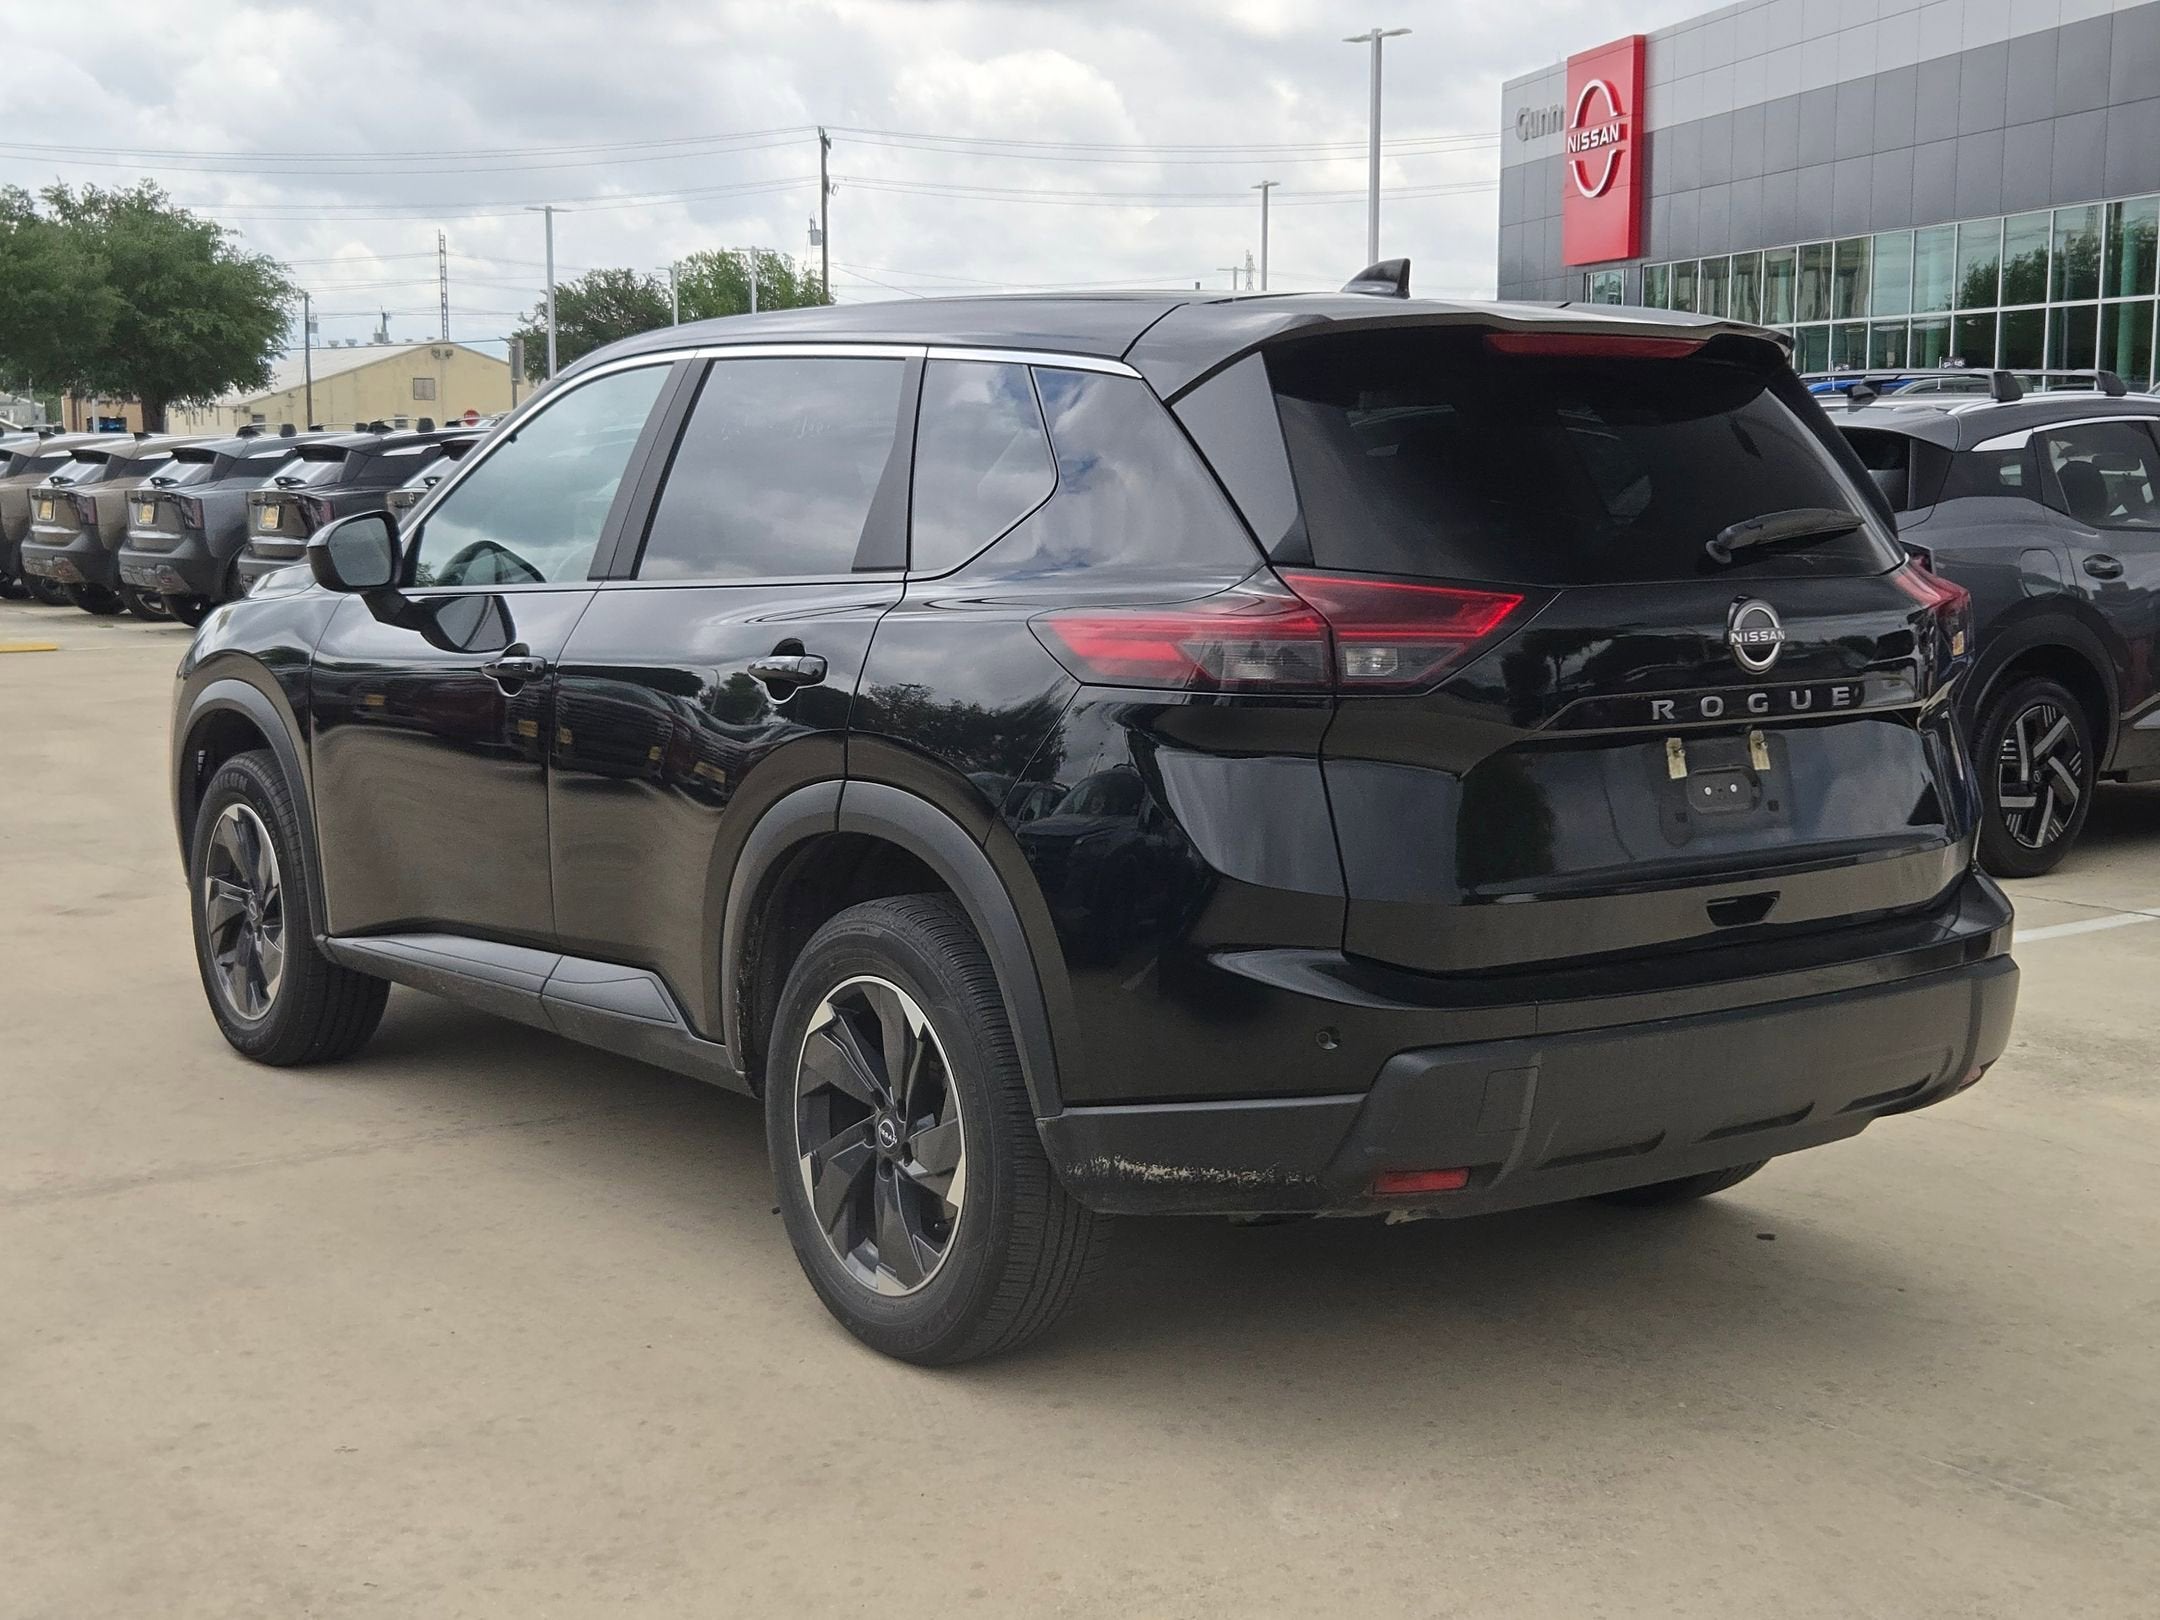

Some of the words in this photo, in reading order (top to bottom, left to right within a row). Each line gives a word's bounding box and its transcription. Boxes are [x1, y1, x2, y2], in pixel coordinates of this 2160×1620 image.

[1515, 104, 1564, 142] Gunn
[1567, 123, 1619, 154] NISSAN
[1730, 630, 1785, 644] NISSAN
[1651, 687, 1850, 720] ROGUE
